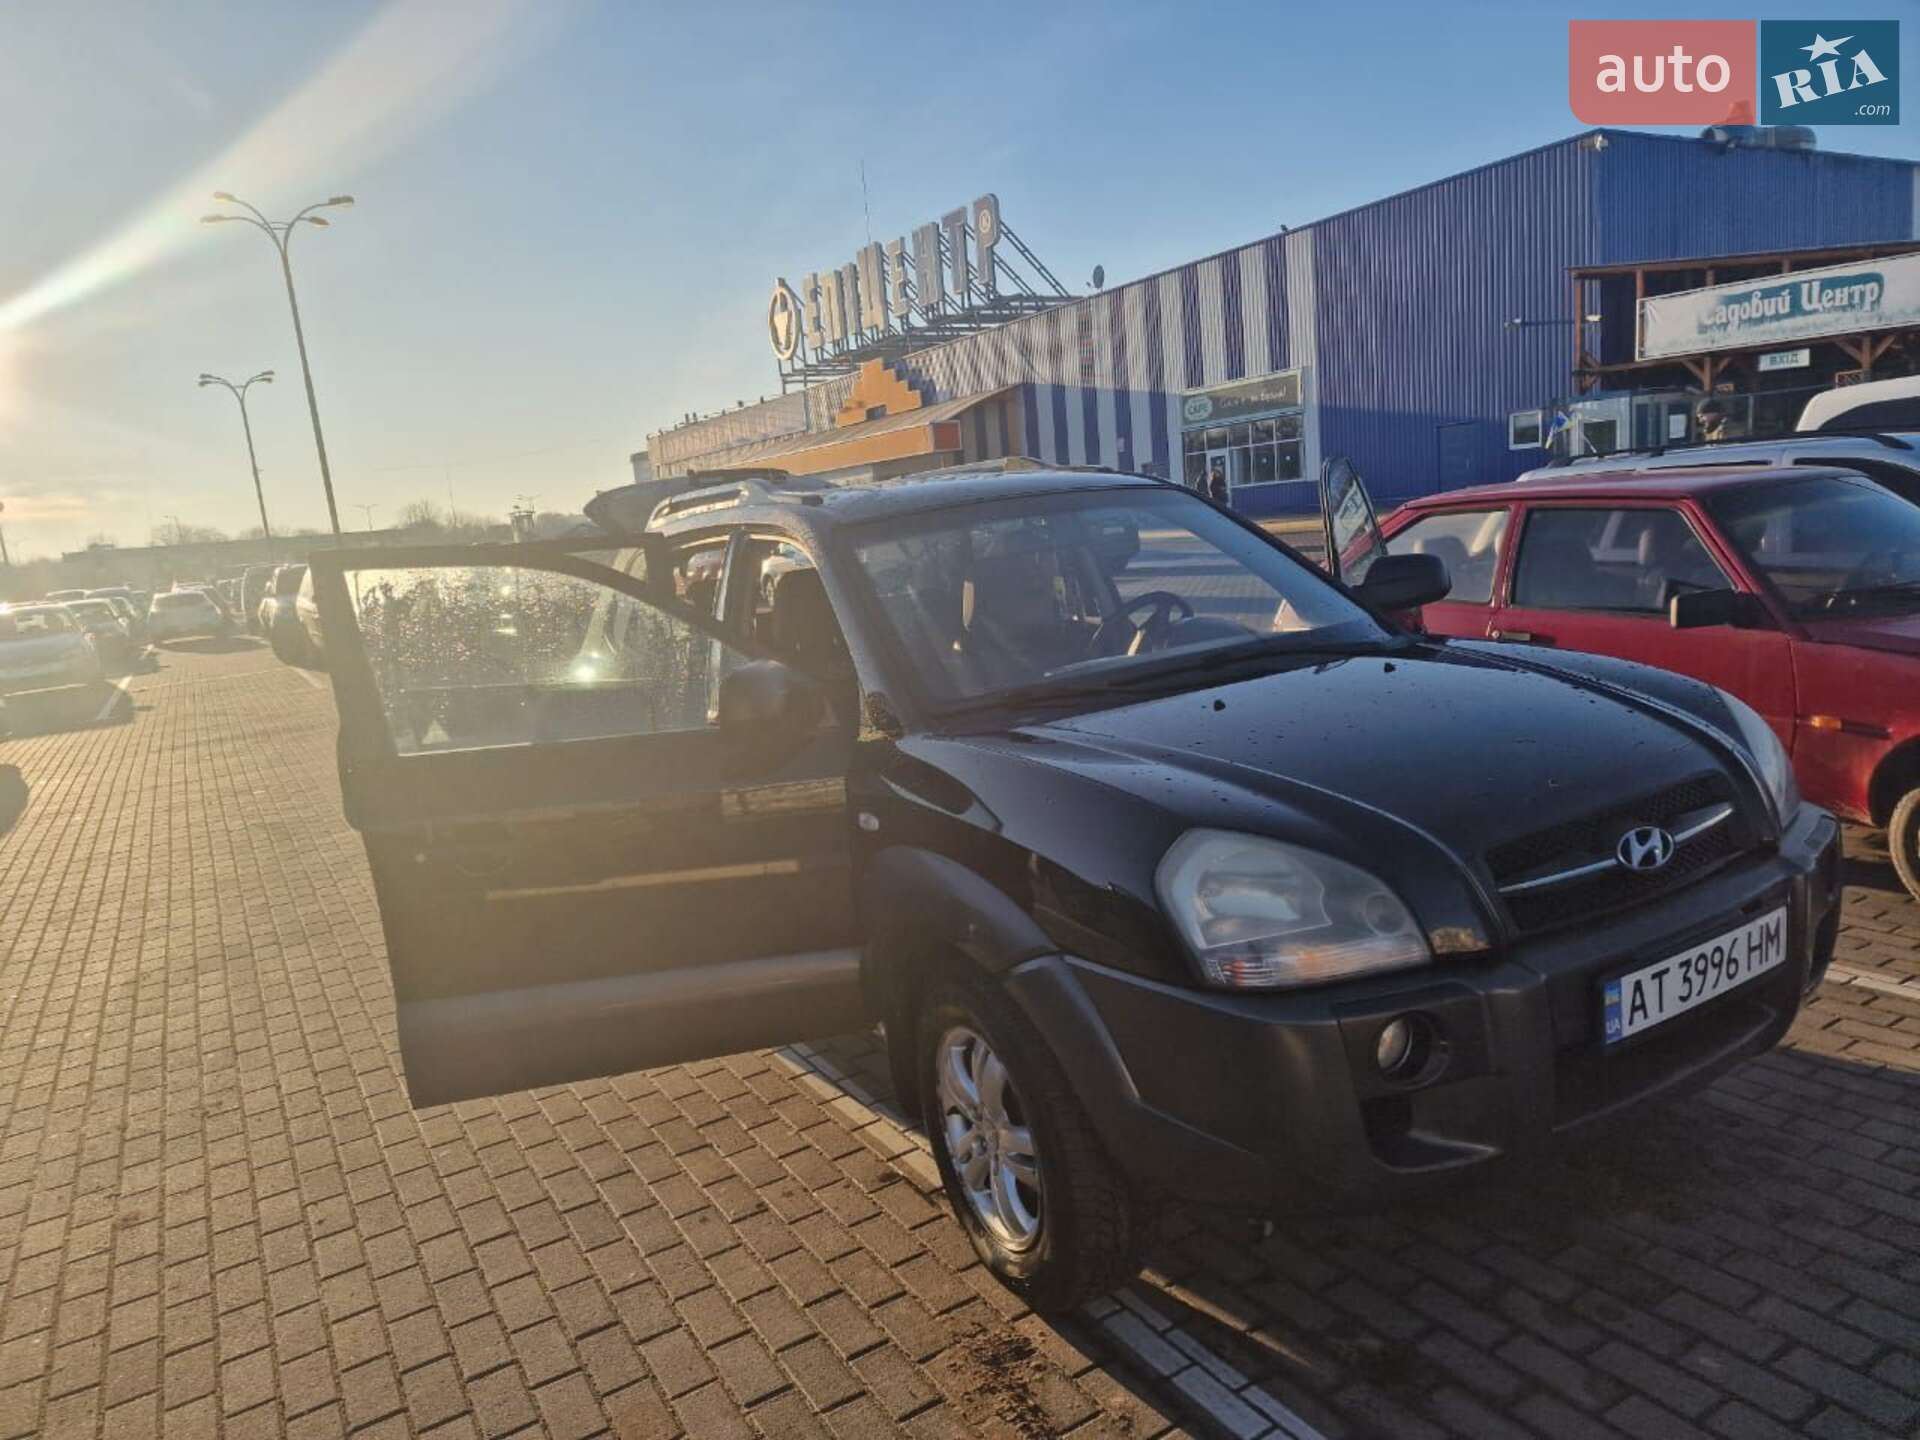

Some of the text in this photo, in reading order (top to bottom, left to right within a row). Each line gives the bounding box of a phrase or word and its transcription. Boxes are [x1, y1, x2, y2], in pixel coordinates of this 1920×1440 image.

[1801, 280, 1880, 312] Центр
[1628, 915, 1781, 1026] AT 3996 HM
[1606, 1020, 1621, 1034] UA
